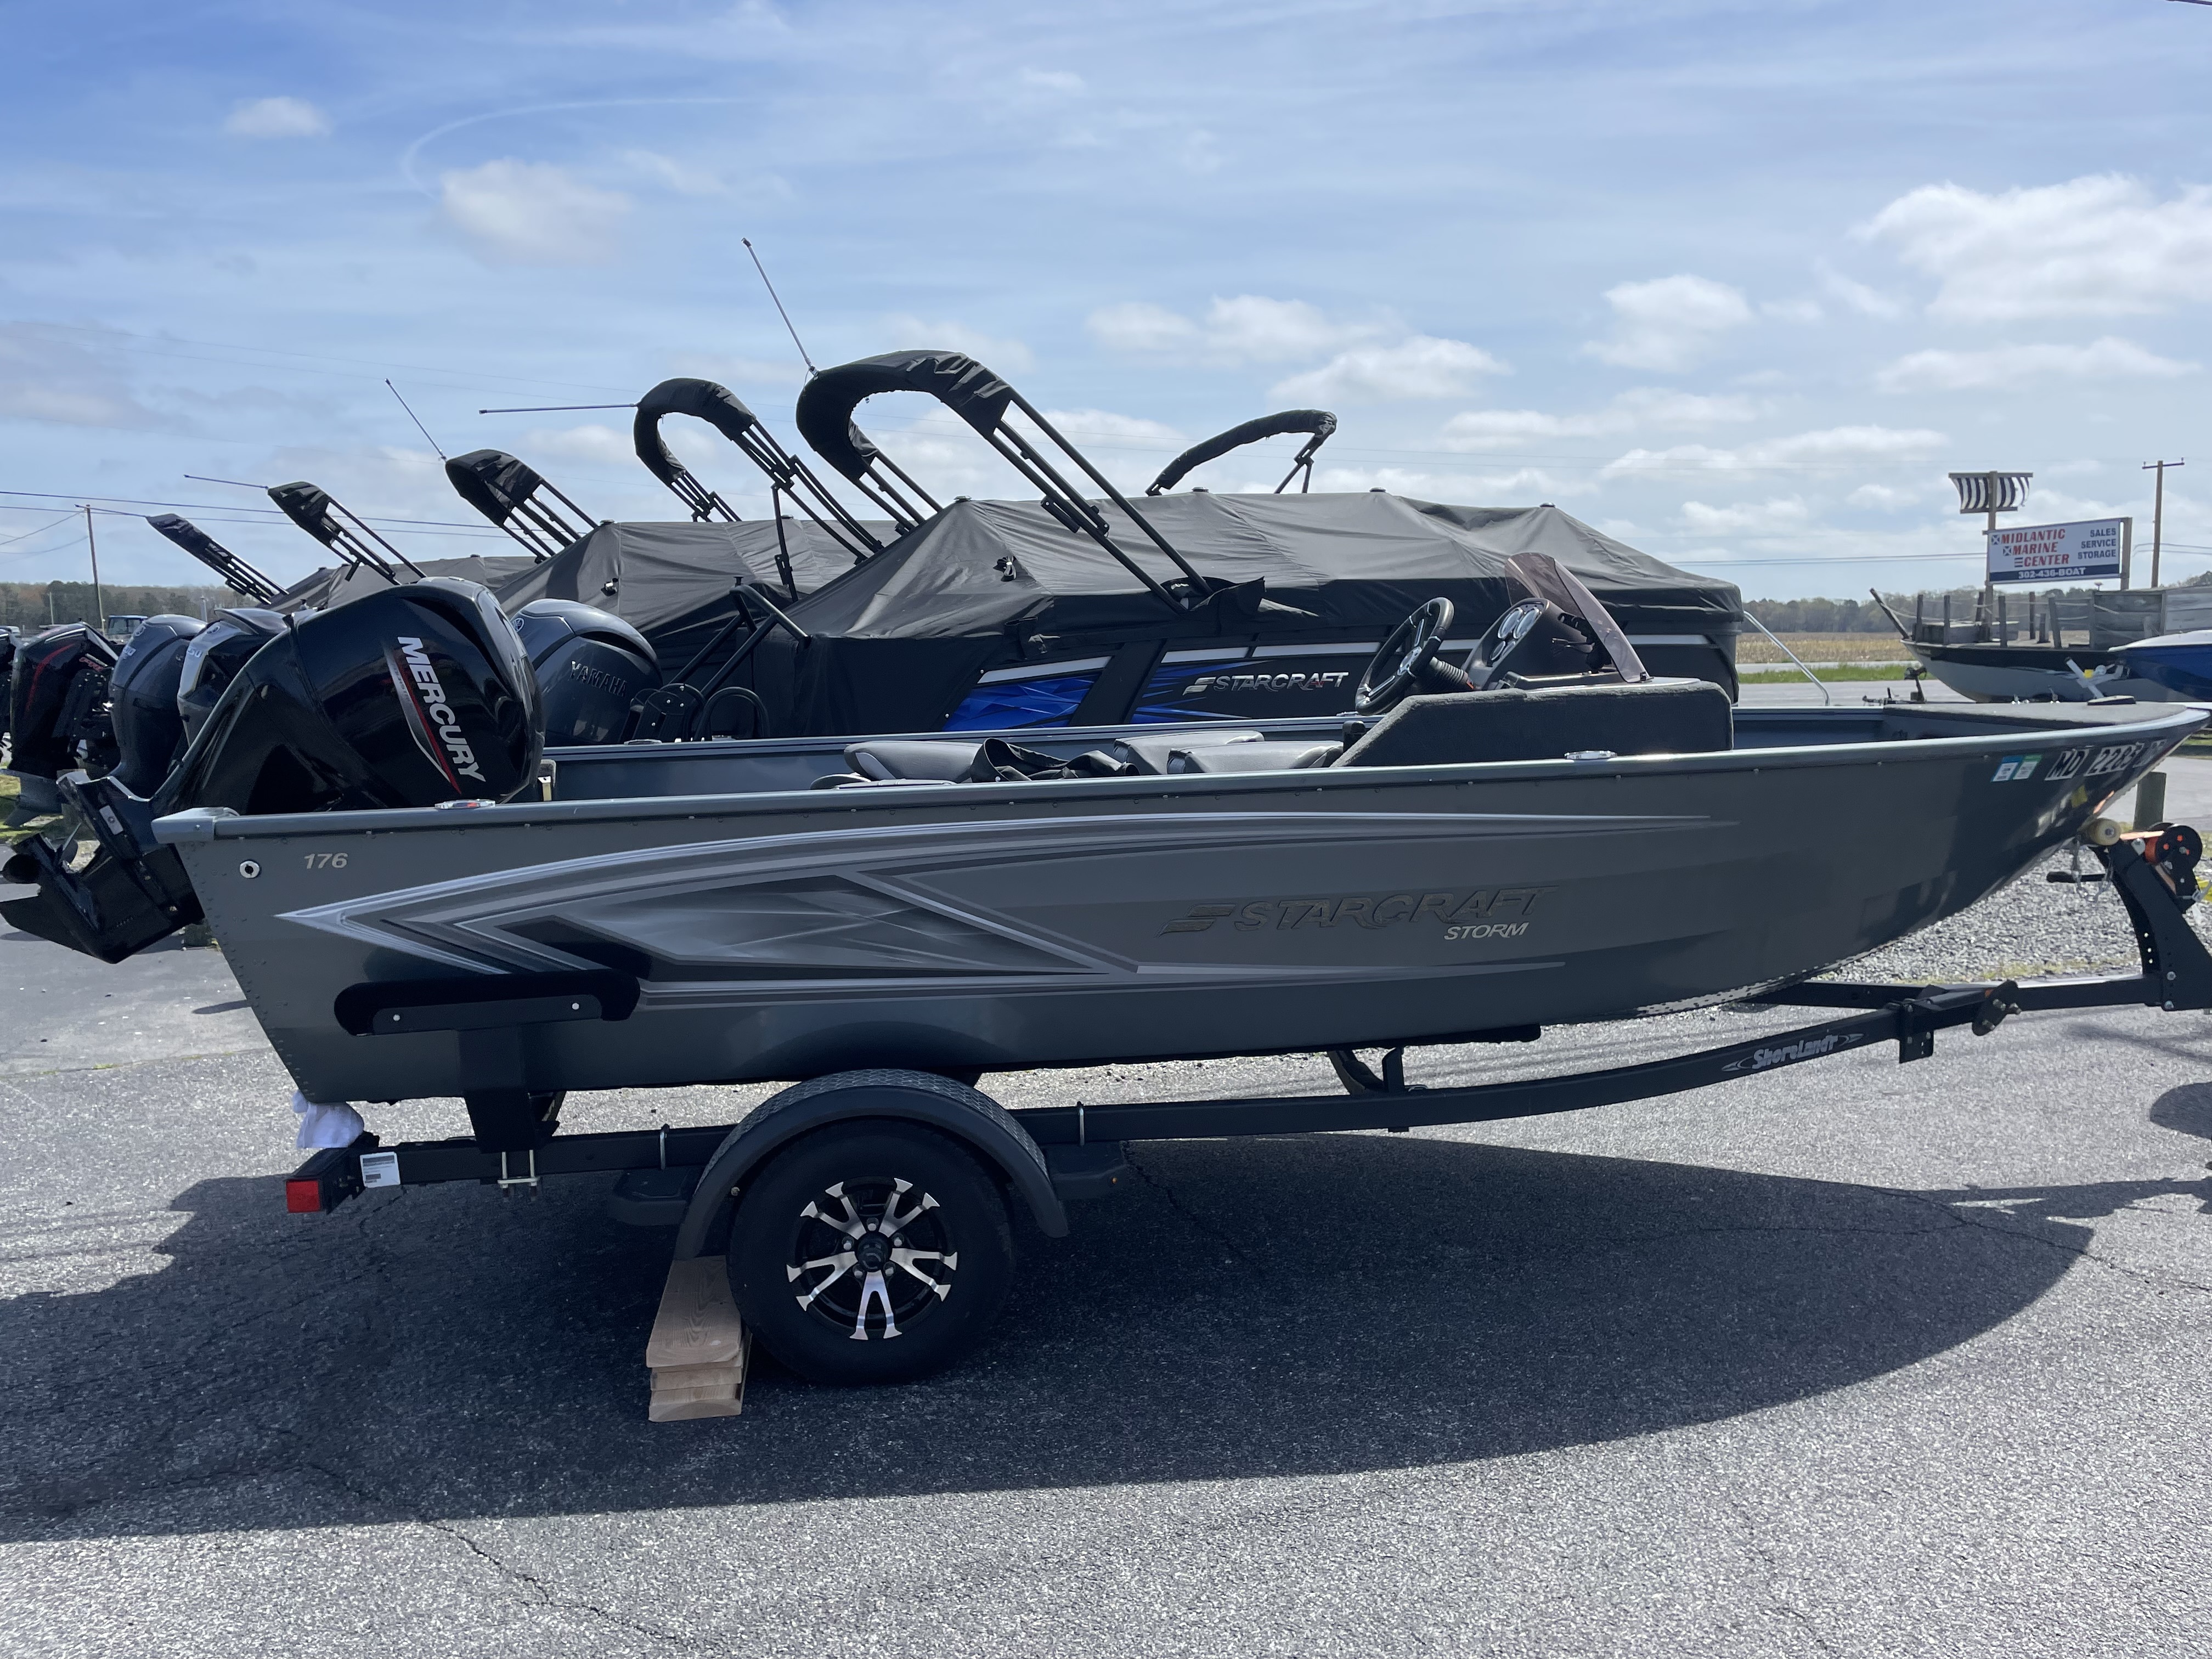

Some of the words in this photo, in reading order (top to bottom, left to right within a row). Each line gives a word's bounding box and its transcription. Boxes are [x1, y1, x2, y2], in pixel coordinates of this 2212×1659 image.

[2001, 528, 2066, 544] MIDLANTIC
[2090, 528, 2116, 538] SALES
[2012, 541, 2058, 556] MARINE
[2081, 539, 2116, 549] SERVICE
[2024, 554, 2069, 567] CENTER
[2078, 549, 2116, 560] STORAGE
[569, 661, 628, 697] YAMAHA
[1213, 672, 1349, 692] STARCRAFT
[397, 636, 486, 782] MERCURY
[2048, 750, 2087, 778] MD
[303, 853, 348, 869] 176
[1232, 884, 1560, 930] STARCRAFT
[1443, 922, 1530, 941] STORM
